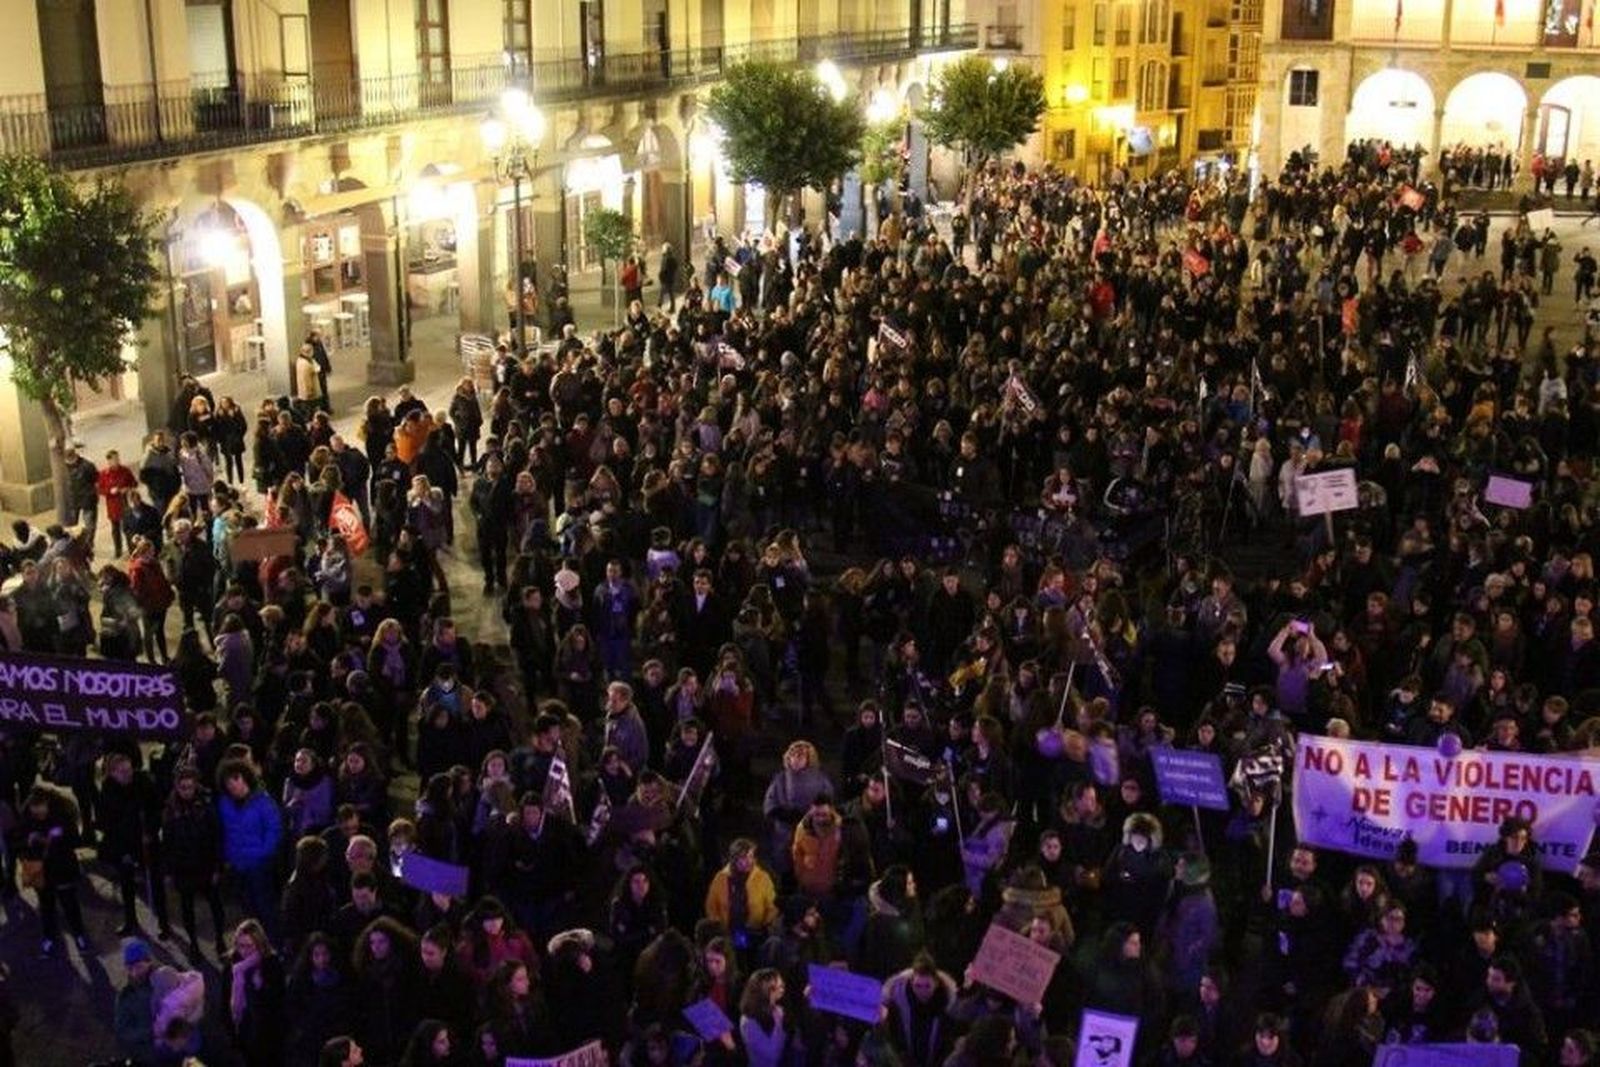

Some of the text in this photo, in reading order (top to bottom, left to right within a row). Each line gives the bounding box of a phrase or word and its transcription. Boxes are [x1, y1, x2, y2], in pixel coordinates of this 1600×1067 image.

[63, 669, 176, 698] NOSOTRAS
[0, 698, 179, 729] RA EL MUNDO
[1304, 745, 1343, 776] NO
[1354, 752, 1371, 779] A
[1384, 755, 1420, 783] LA
[1434, 758, 1595, 796] VIOLENCIA
[1352, 787, 1537, 824] DE GENERO
[1445, 839, 1578, 856] BENNTE
